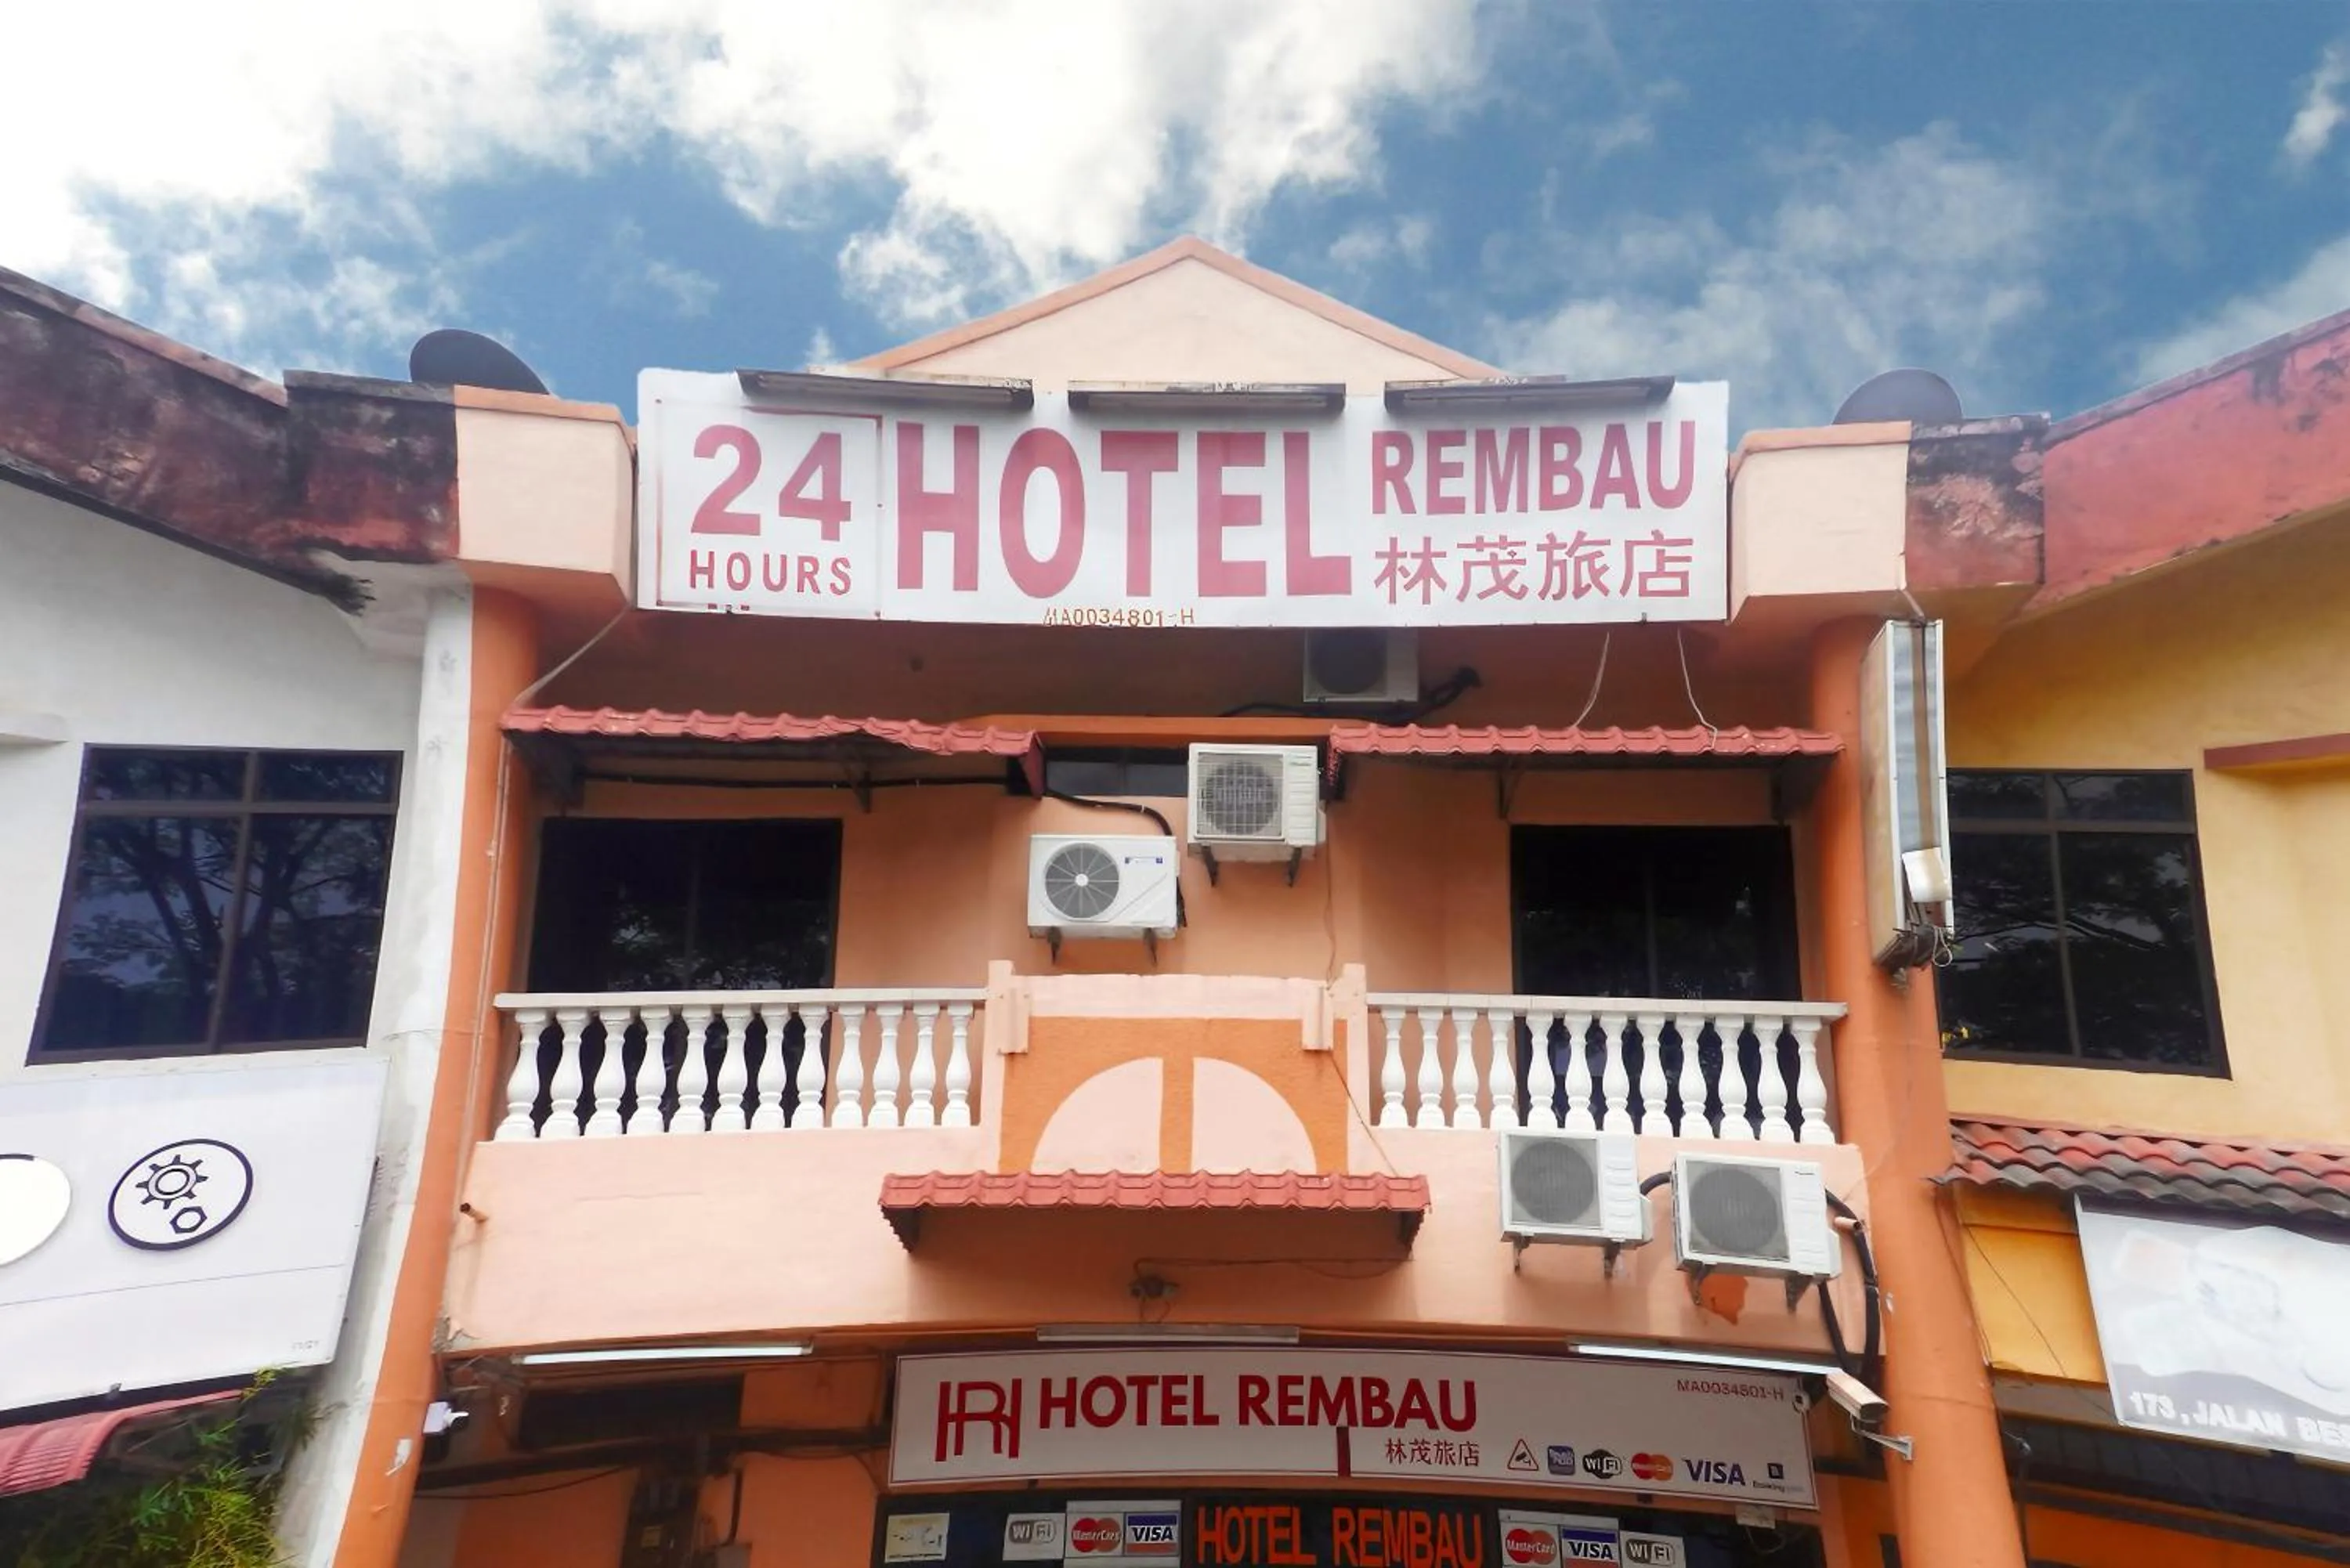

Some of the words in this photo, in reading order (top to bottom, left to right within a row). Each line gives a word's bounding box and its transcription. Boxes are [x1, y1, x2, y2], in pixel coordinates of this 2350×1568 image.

[689, 425, 851, 542] 24
[1372, 421, 1695, 515] REMBAU
[896, 421, 1352, 598] HOTEL
[689, 549, 851, 596] HOURS
[1373, 529, 1694, 605] 林茂旅店
[1039, 1374, 1220, 1429] HOTEL
[1238, 1374, 1477, 1432] REMBAU
[2193, 1400, 2288, 1438] JALAN
[1385, 1437, 1480, 1467] 林茂旅店
[1683, 1459, 1746, 1487] VISA
[1133, 1526, 1173, 1542] VISA
[1198, 1506, 1317, 1565] HOTEL
[1333, 1508, 1483, 1568] REMBAU
[1568, 1541, 1614, 1560] VISA
